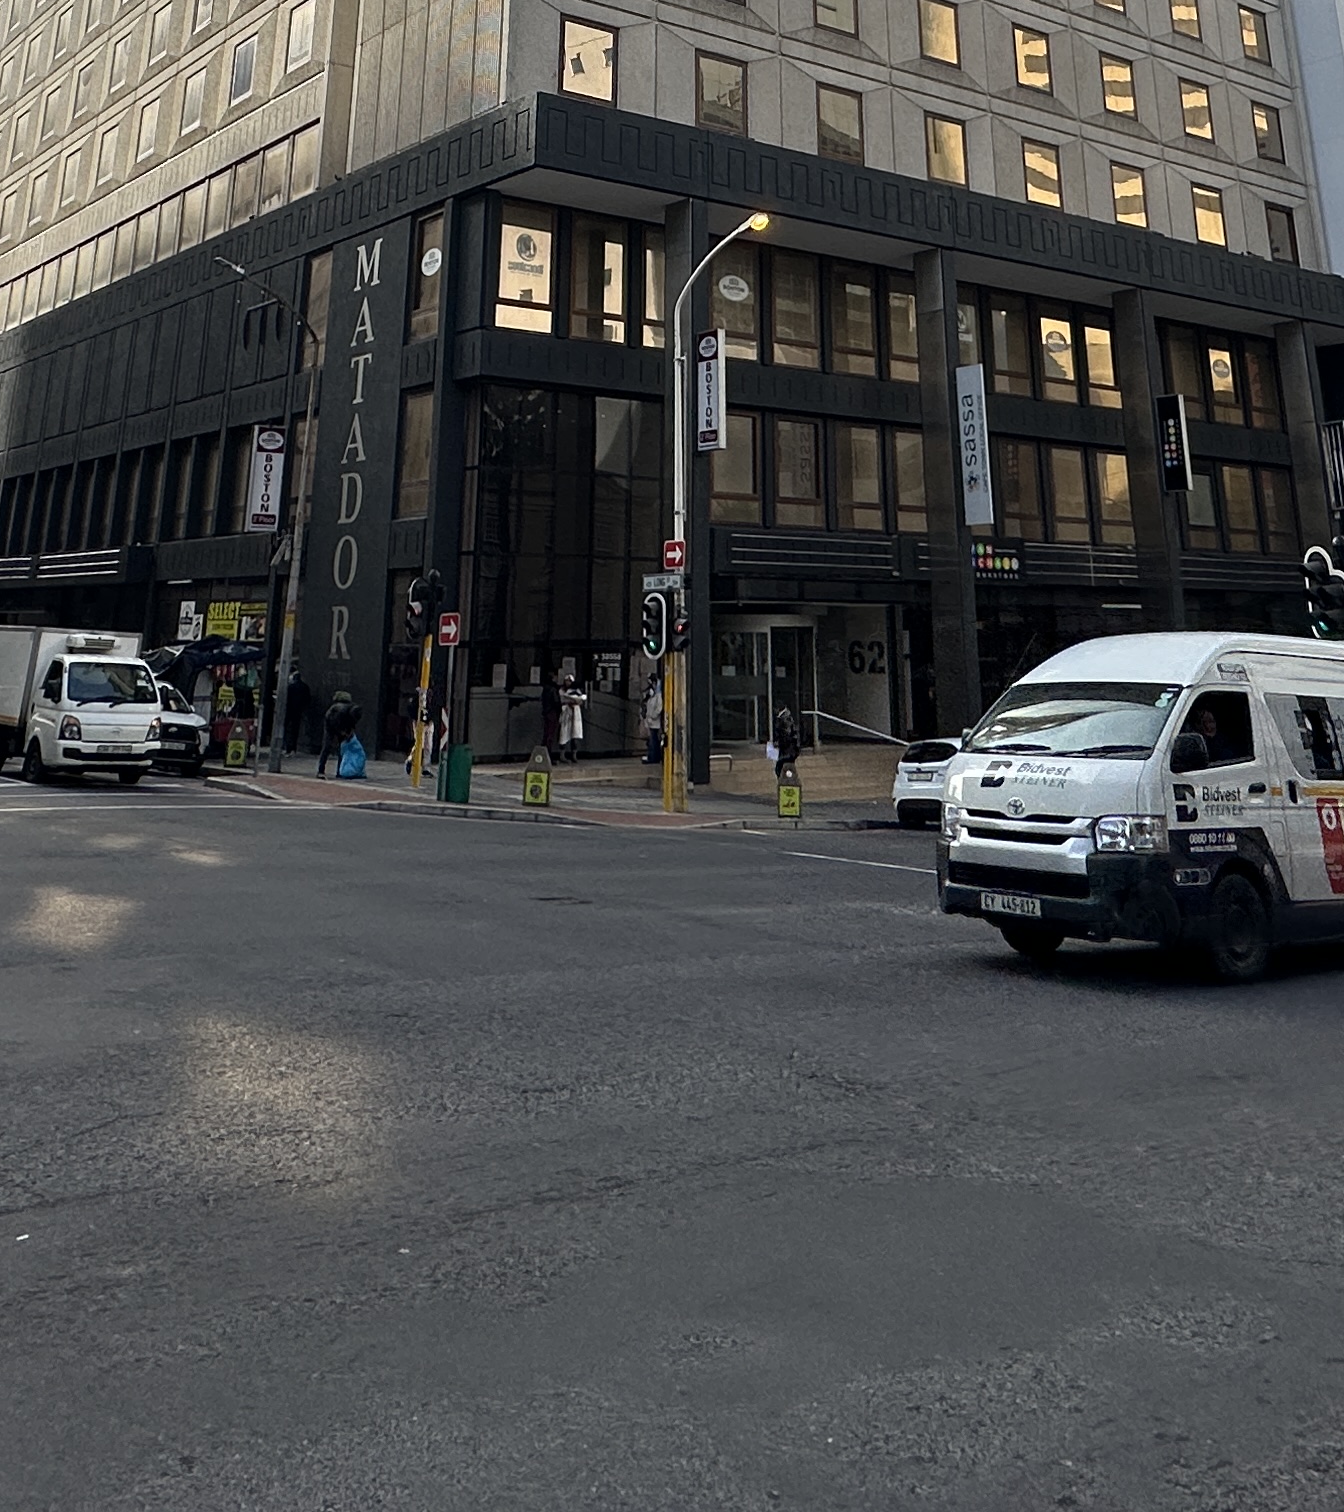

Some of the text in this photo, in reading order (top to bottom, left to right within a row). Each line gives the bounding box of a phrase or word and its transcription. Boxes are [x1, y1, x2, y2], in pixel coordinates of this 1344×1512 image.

[705, 362, 713, 429] BOSTON
[328, 237, 383, 661] MATADOR
[962, 394, 977, 467] sassa
[260, 454, 273, 512] BOSTON
[207, 601, 241, 619] SELECT
[848, 640, 886, 674] 62
[1017, 762, 1071, 776] Bidvest
[1202, 786, 1242, 802] Bidvest
